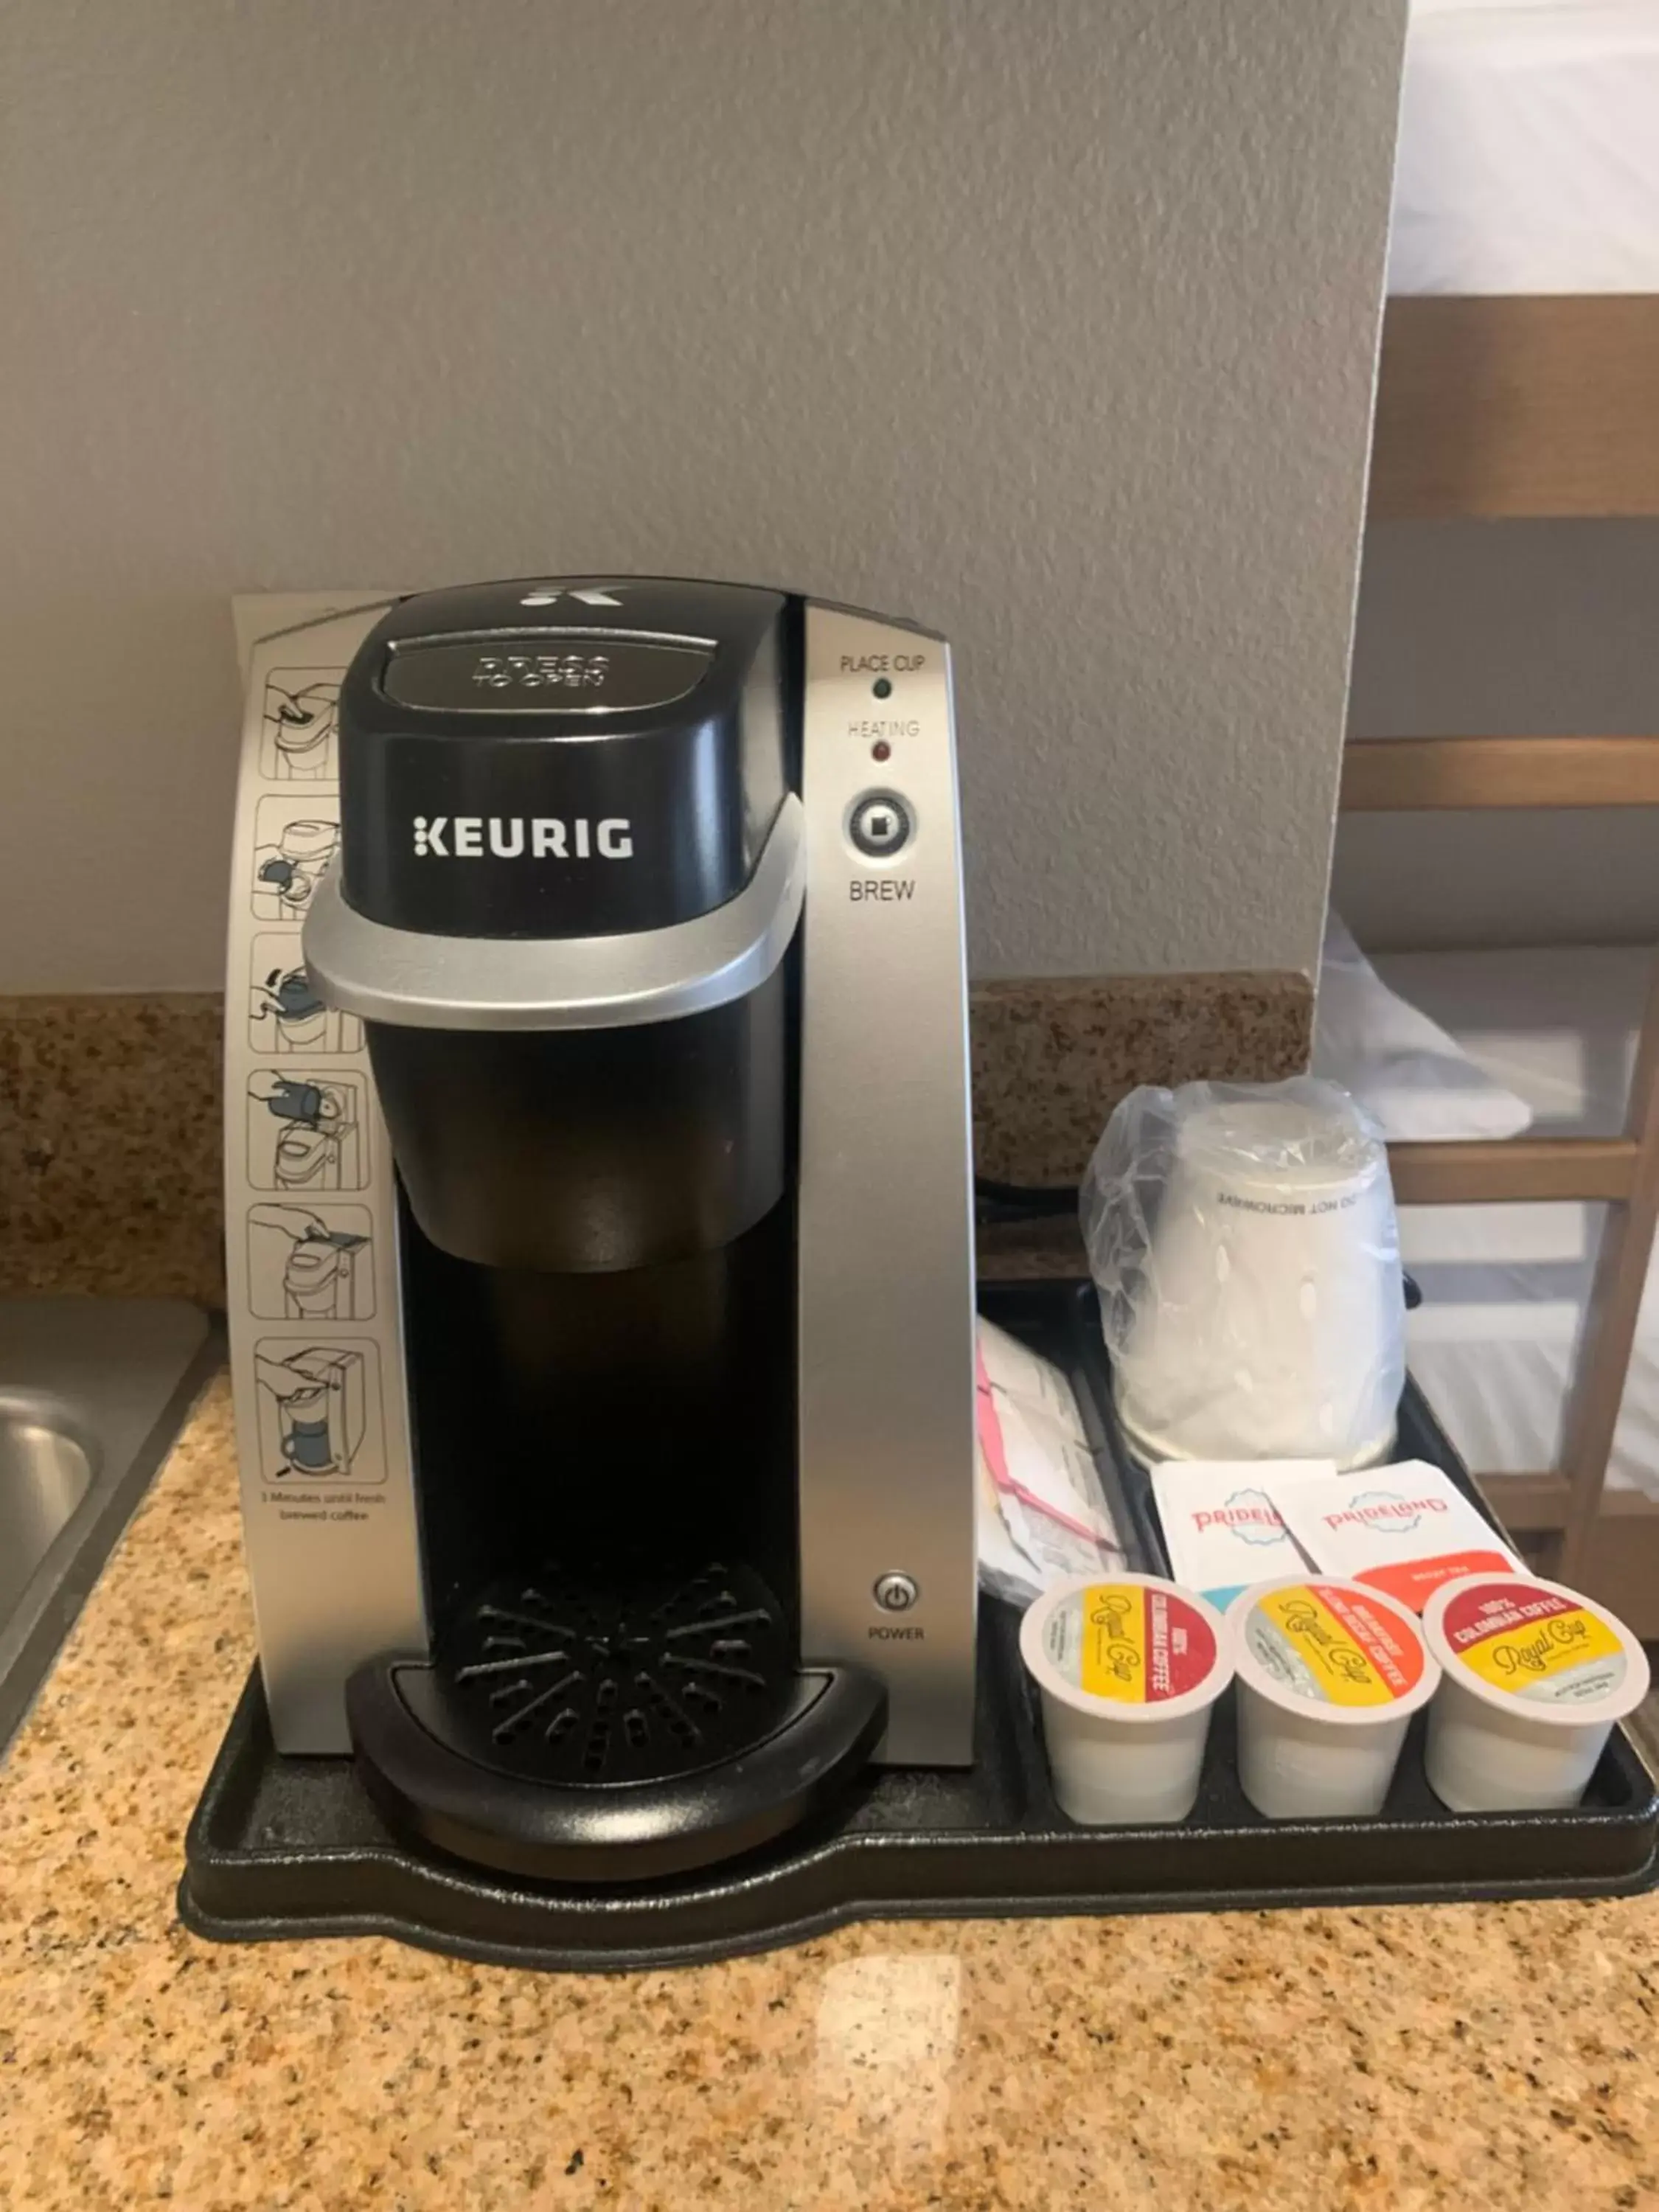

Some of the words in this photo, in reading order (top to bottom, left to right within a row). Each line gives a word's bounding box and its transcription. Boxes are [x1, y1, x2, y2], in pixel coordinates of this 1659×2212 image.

[841, 655, 888, 672] PLACE
[894, 655, 925, 672] CUP
[519, 672, 605, 687] OPEN
[848, 720, 921, 737] HEATING
[413, 816, 634, 860] KEURIG
[849, 880, 916, 901] BREW
[1217, 1192, 1307, 1215] MICROWAVE
[1308, 1200, 1338, 1214] NOT
[330, 1509, 369, 1521] coffee
[1323, 1498, 1449, 1531] PRIDELAND
[1520, 1596, 1567, 1618] COFFEE
[868, 1627, 925, 1640] POWER
[1492, 1630, 1554, 1675] Royal
[1547, 1619, 1593, 1645] Cup
[1107, 1643, 1141, 1683] Cup
[1152, 1647, 1172, 1694] COFFEE
